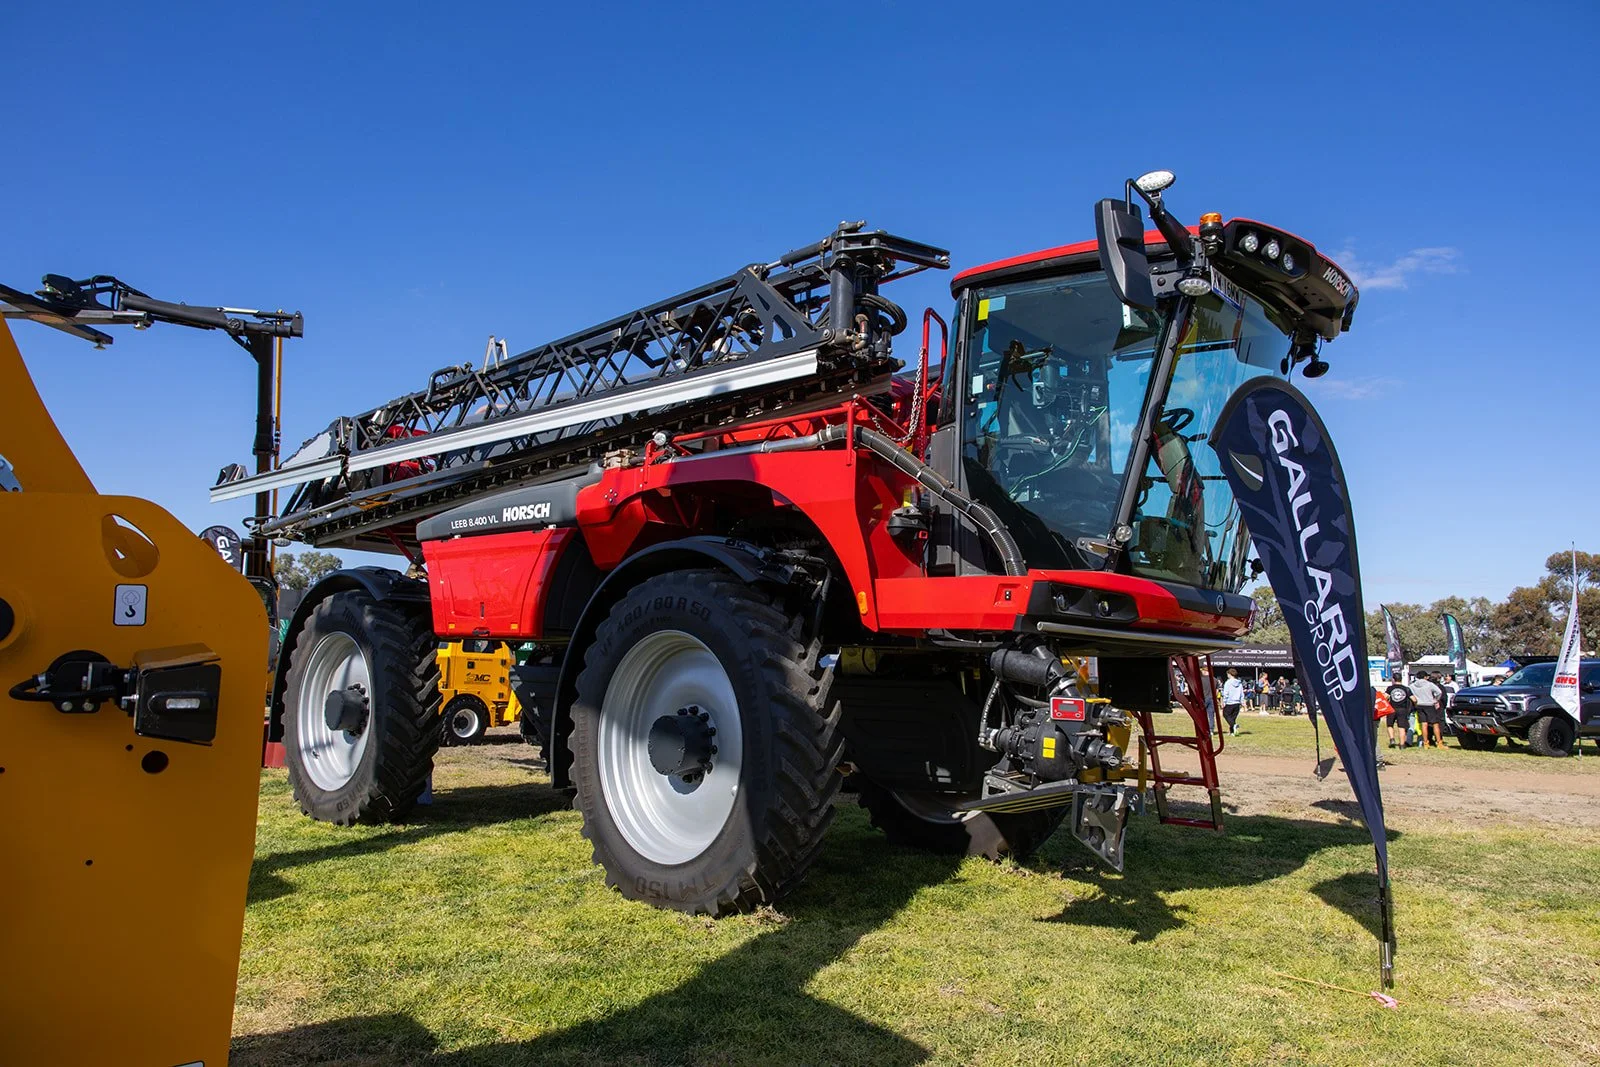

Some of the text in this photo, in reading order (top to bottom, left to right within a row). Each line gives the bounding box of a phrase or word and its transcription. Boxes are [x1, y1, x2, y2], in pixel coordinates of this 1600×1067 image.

[1322, 267, 1351, 297] HORSCH
[451, 515, 499, 529] LEEB 8.400 VL
[502, 502, 551, 522] HORSCH
[1267, 409, 1358, 692] GALLARD
[1304, 599, 1344, 701] GROUP
